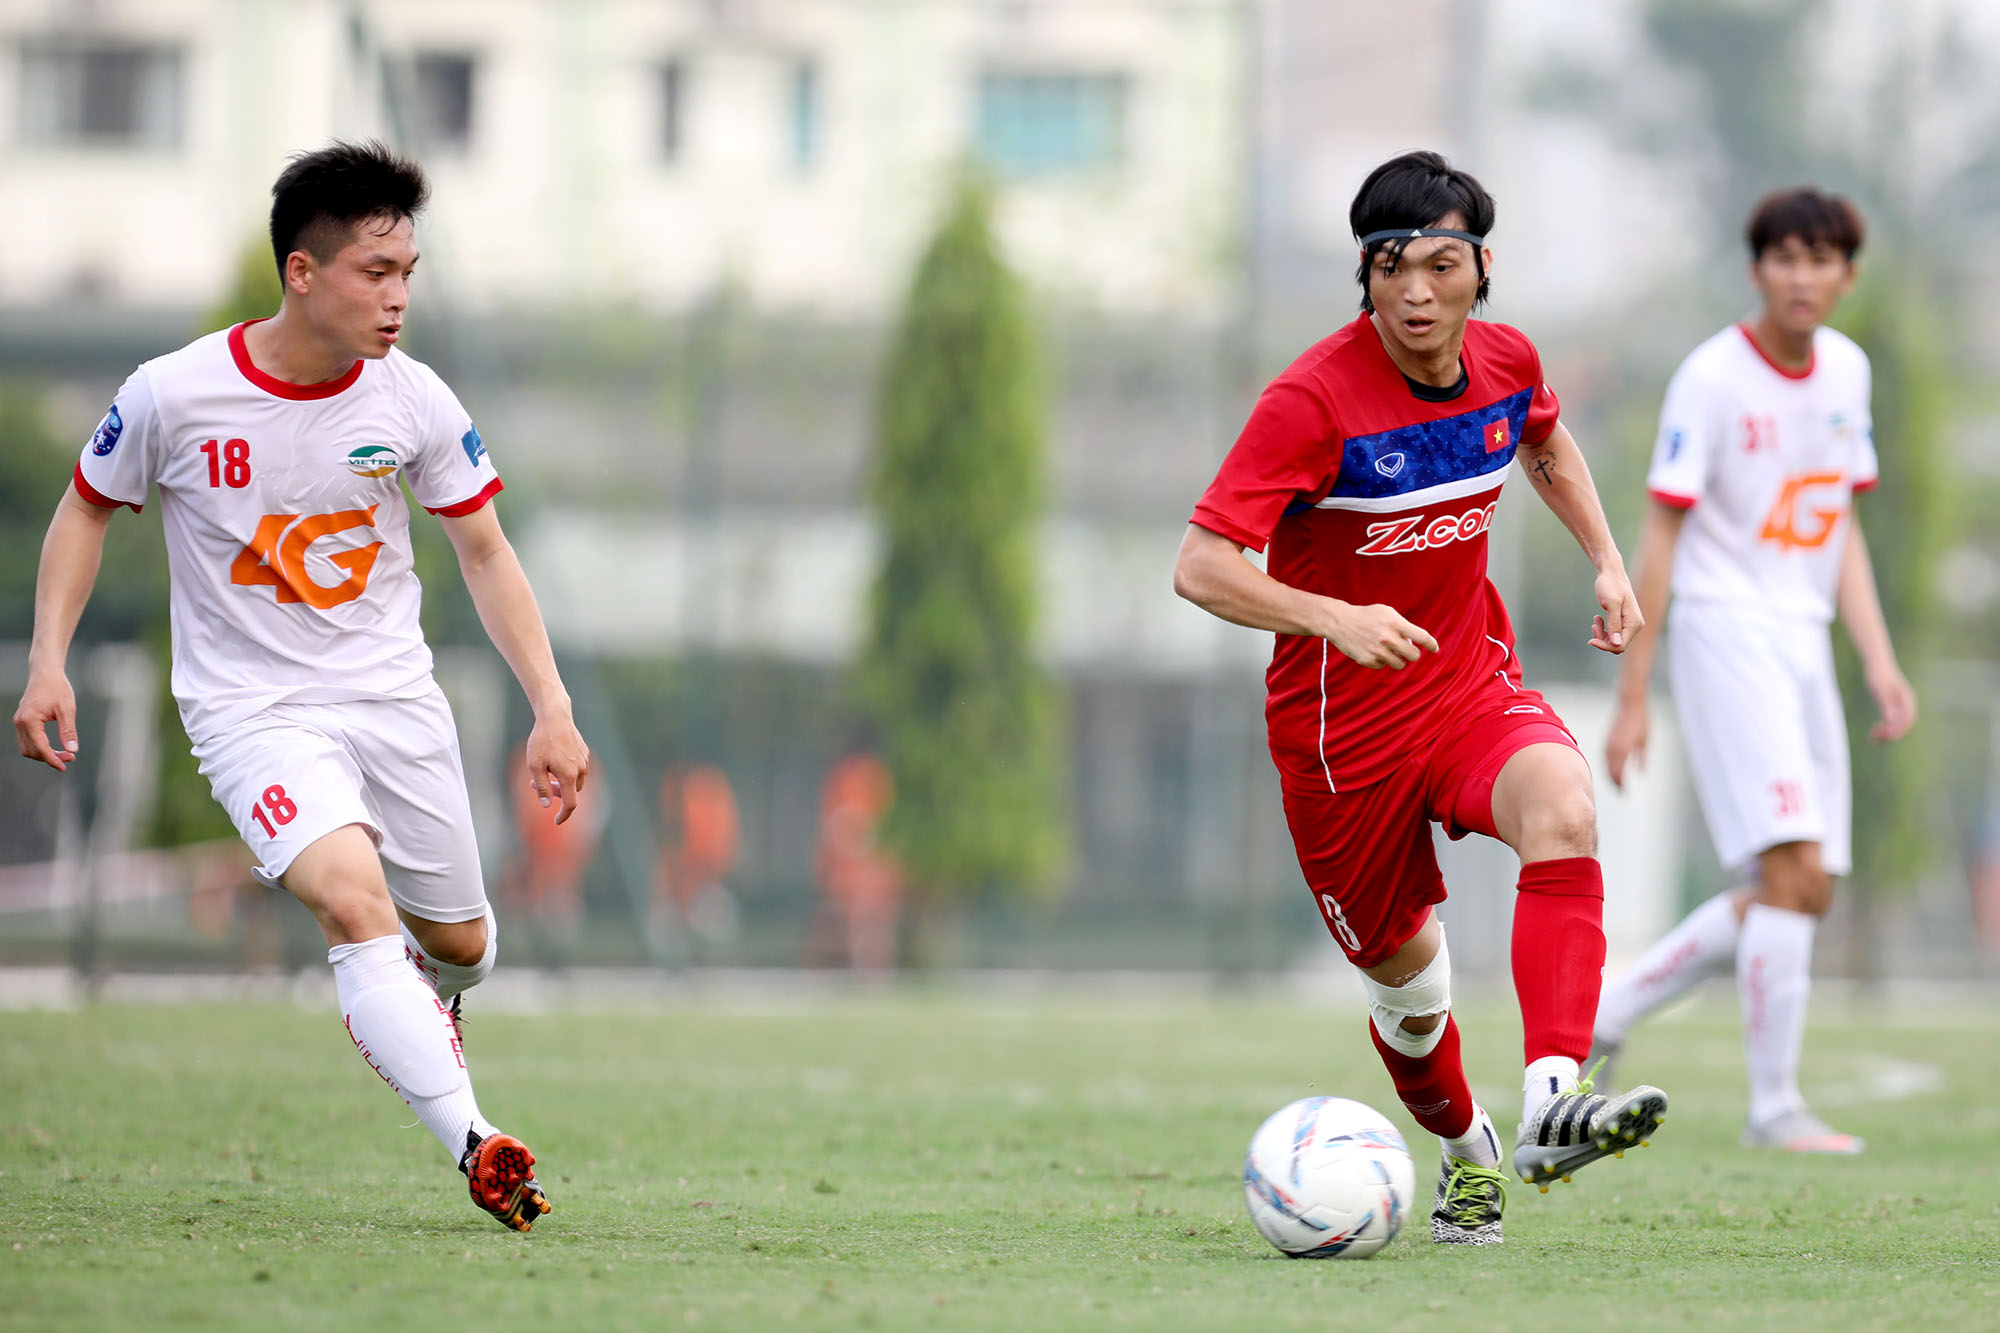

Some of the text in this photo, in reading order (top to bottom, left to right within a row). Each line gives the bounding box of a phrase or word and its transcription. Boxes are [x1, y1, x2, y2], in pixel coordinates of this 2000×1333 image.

[200, 438, 250, 489] 18
[348, 458, 398, 466] VIETTEL
[1759, 473, 1844, 550] 4G
[230, 503, 385, 610] 4G
[251, 784, 298, 840] 18
[1321, 893, 1362, 951] 8
